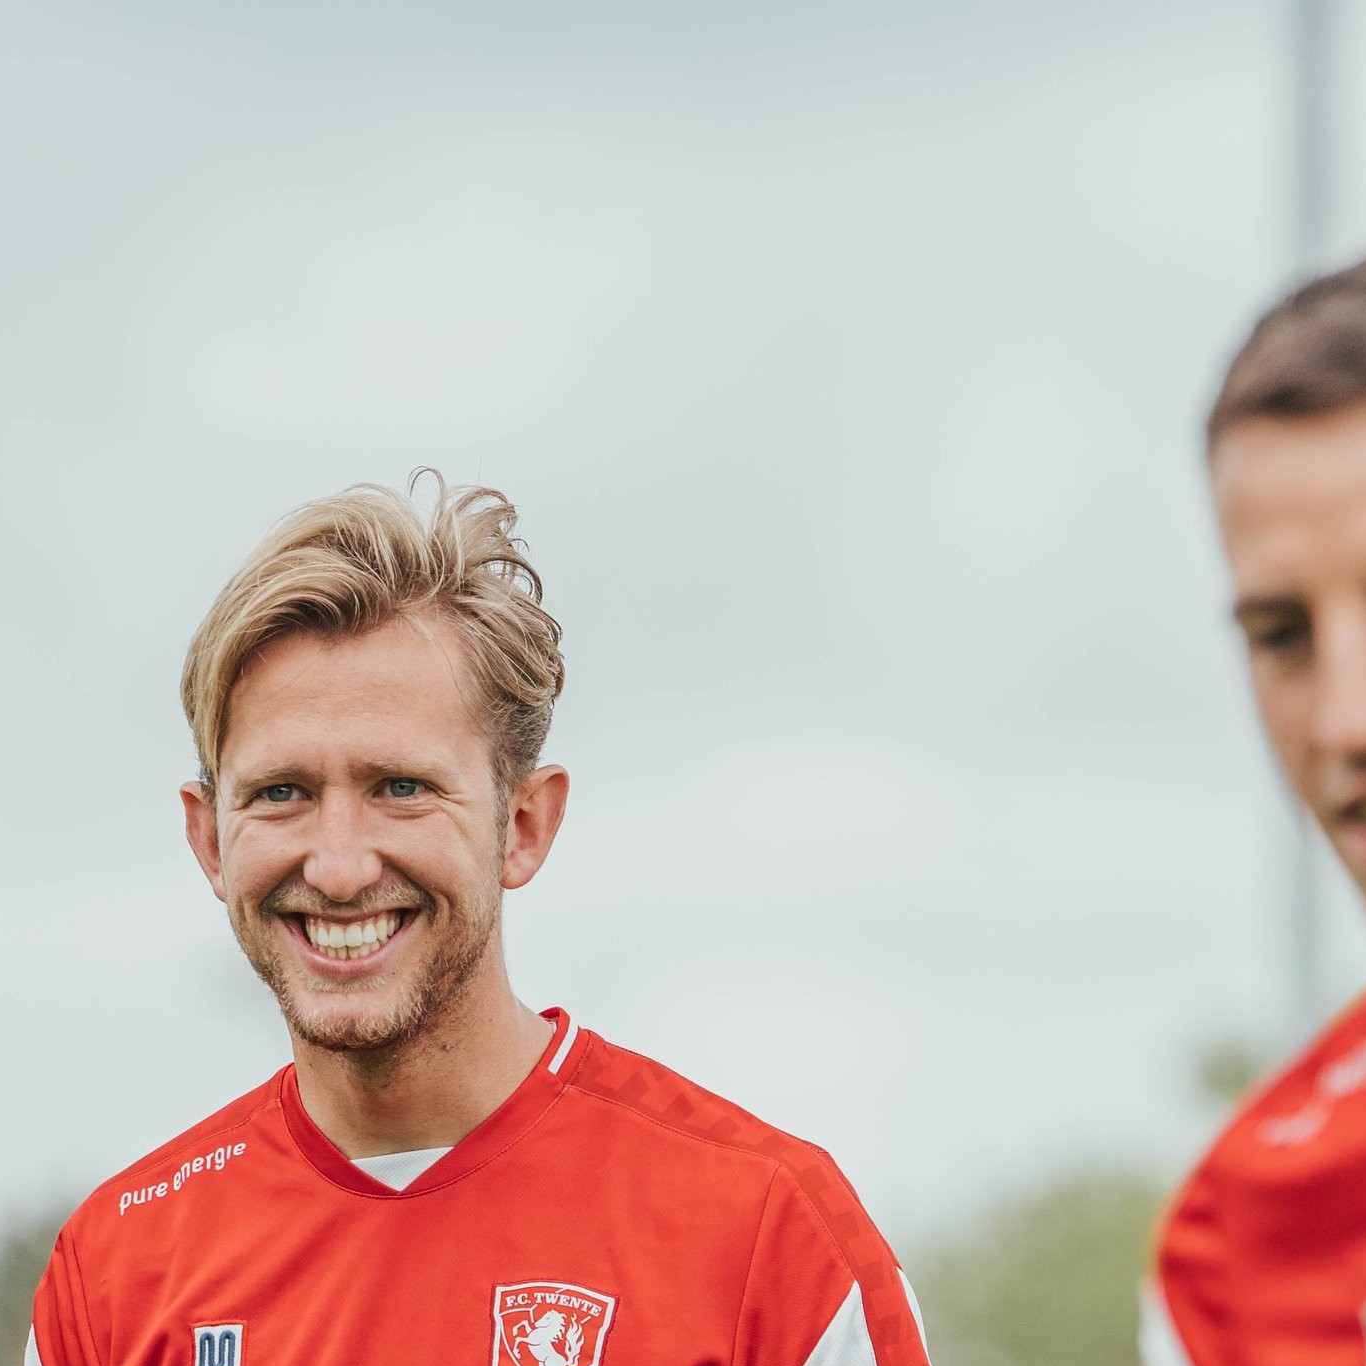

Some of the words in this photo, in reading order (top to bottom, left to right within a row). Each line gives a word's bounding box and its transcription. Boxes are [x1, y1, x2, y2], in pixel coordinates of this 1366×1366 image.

[119, 1181, 168, 1216] pure
[173, 1142, 246, 1190] energie
[505, 1293, 531, 1307] F.C.
[534, 1293, 603, 1317] TWENTE
